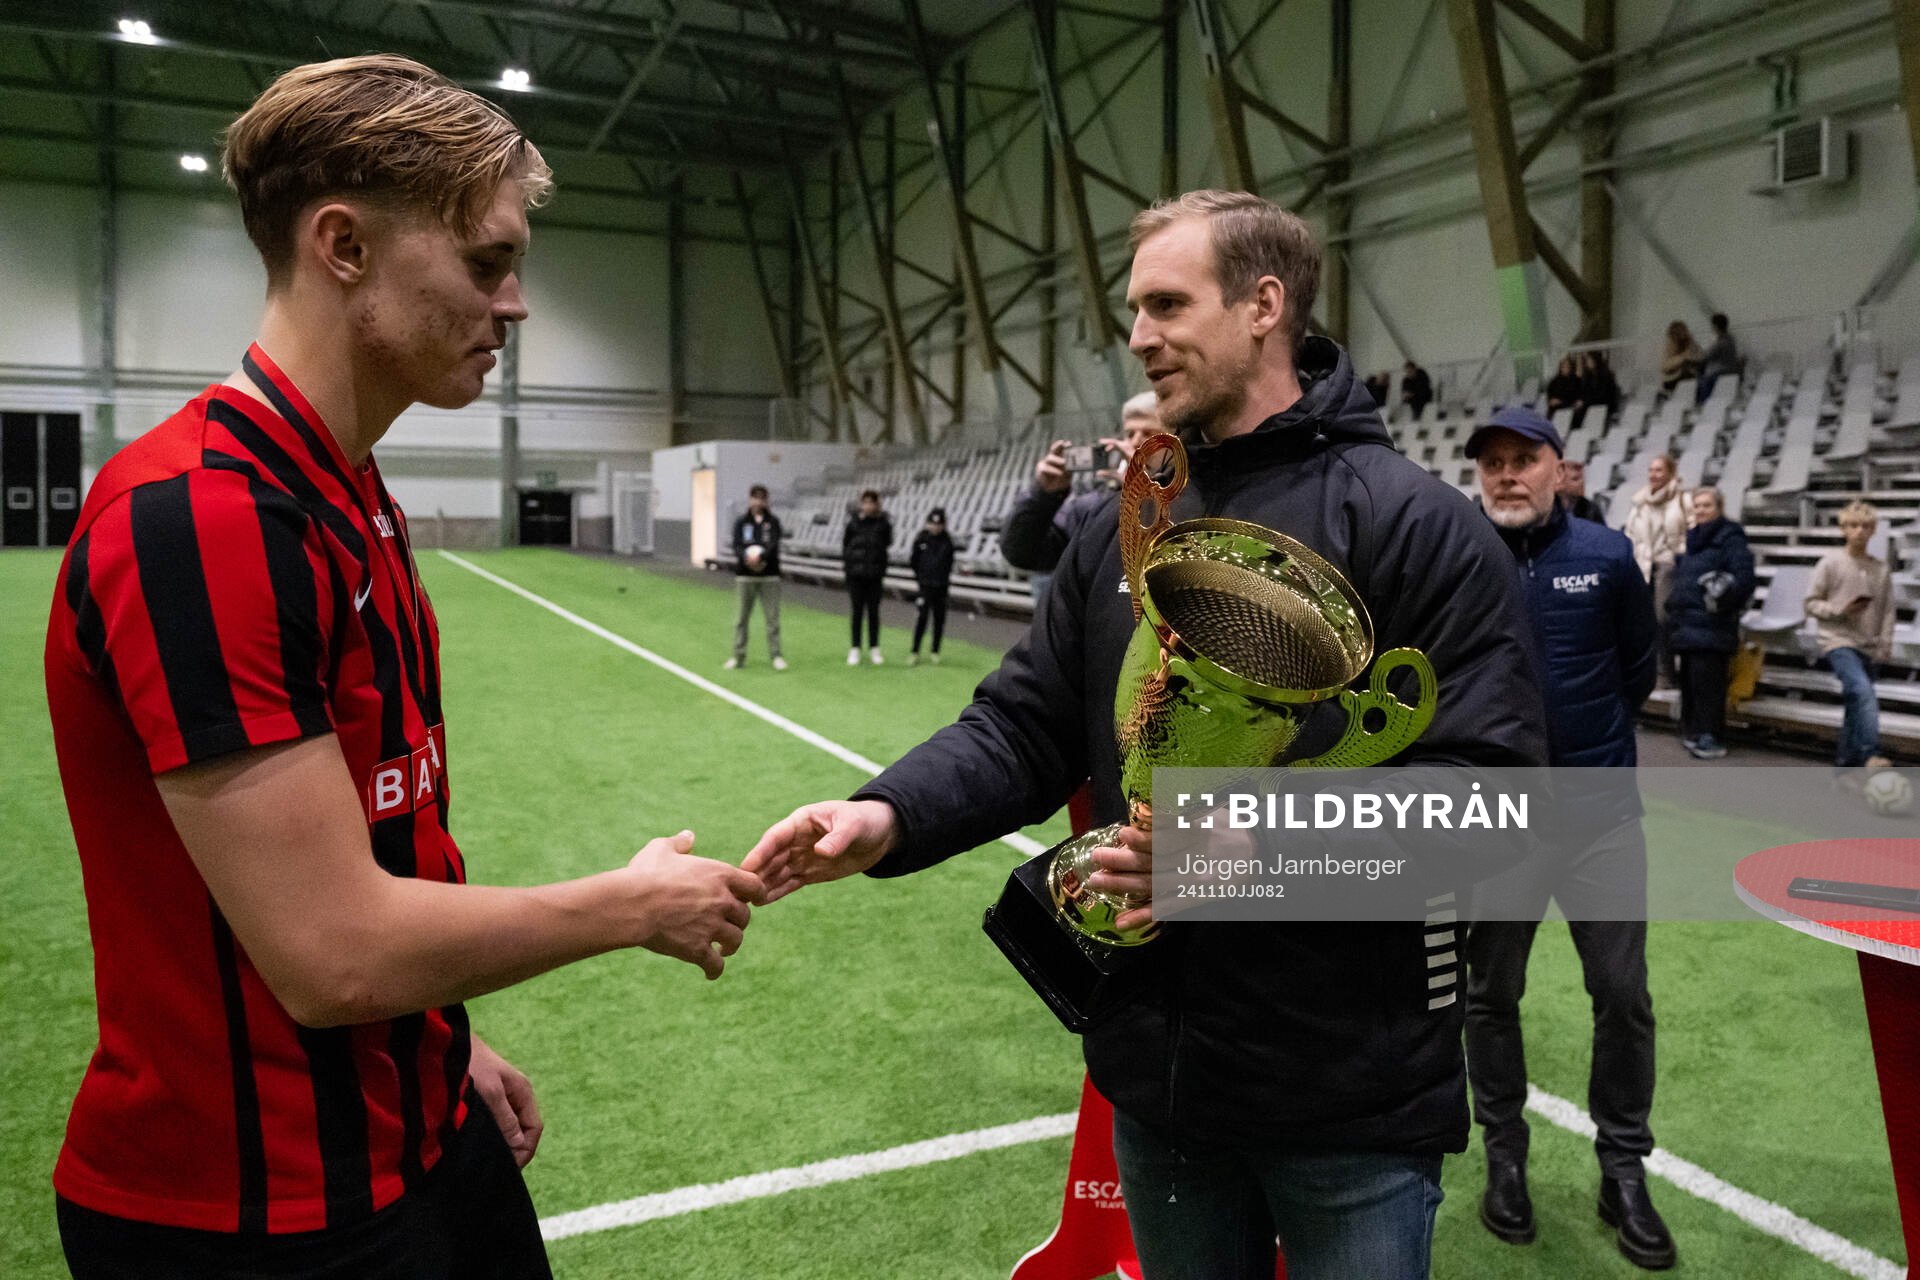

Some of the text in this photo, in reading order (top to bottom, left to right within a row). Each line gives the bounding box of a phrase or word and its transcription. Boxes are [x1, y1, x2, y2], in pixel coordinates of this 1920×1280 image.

[1553, 573, 1599, 589] ESCAPE
[1074, 1180, 1123, 1200] ESCA
[1095, 1200, 1127, 1210] TRAVE
